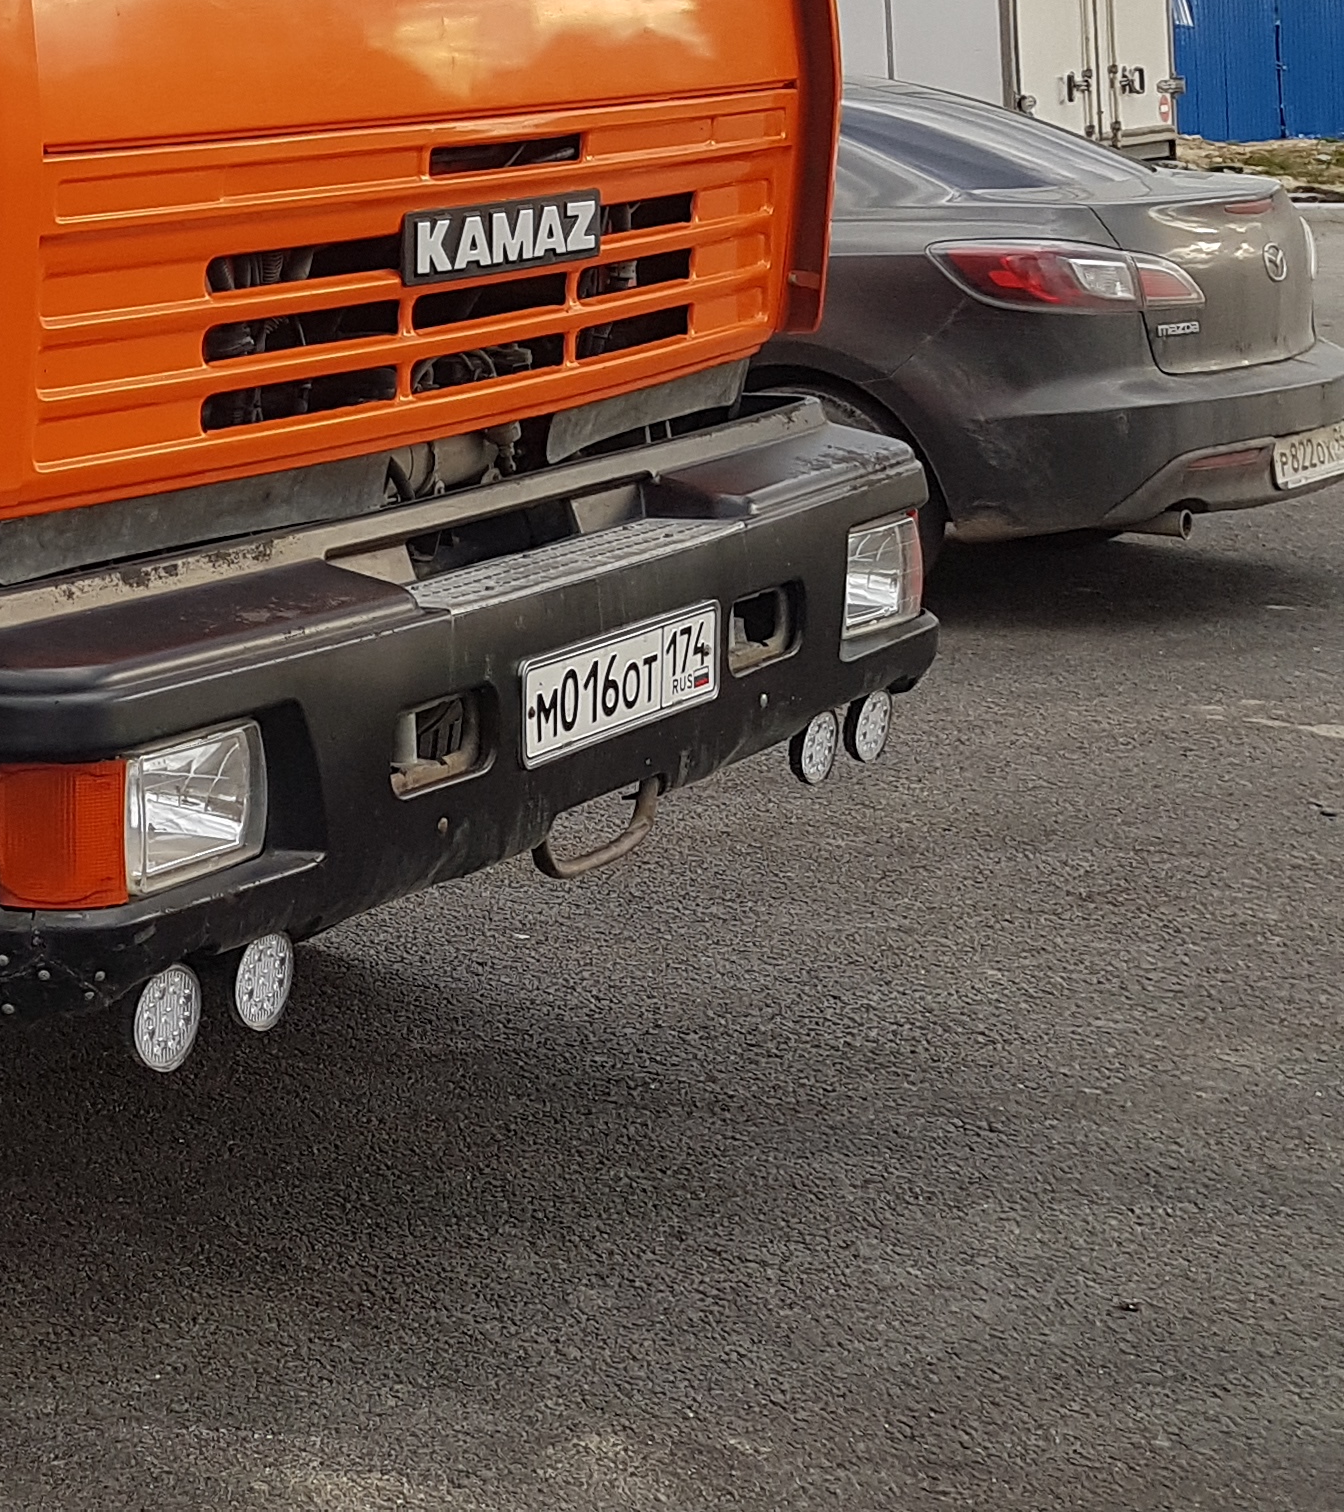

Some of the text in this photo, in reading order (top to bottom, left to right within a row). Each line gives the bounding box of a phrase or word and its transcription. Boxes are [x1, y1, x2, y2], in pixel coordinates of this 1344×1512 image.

[416, 199, 597, 275] KAMAZ
[665, 620, 706, 678] 174
[672, 673, 694, 696] RUS
